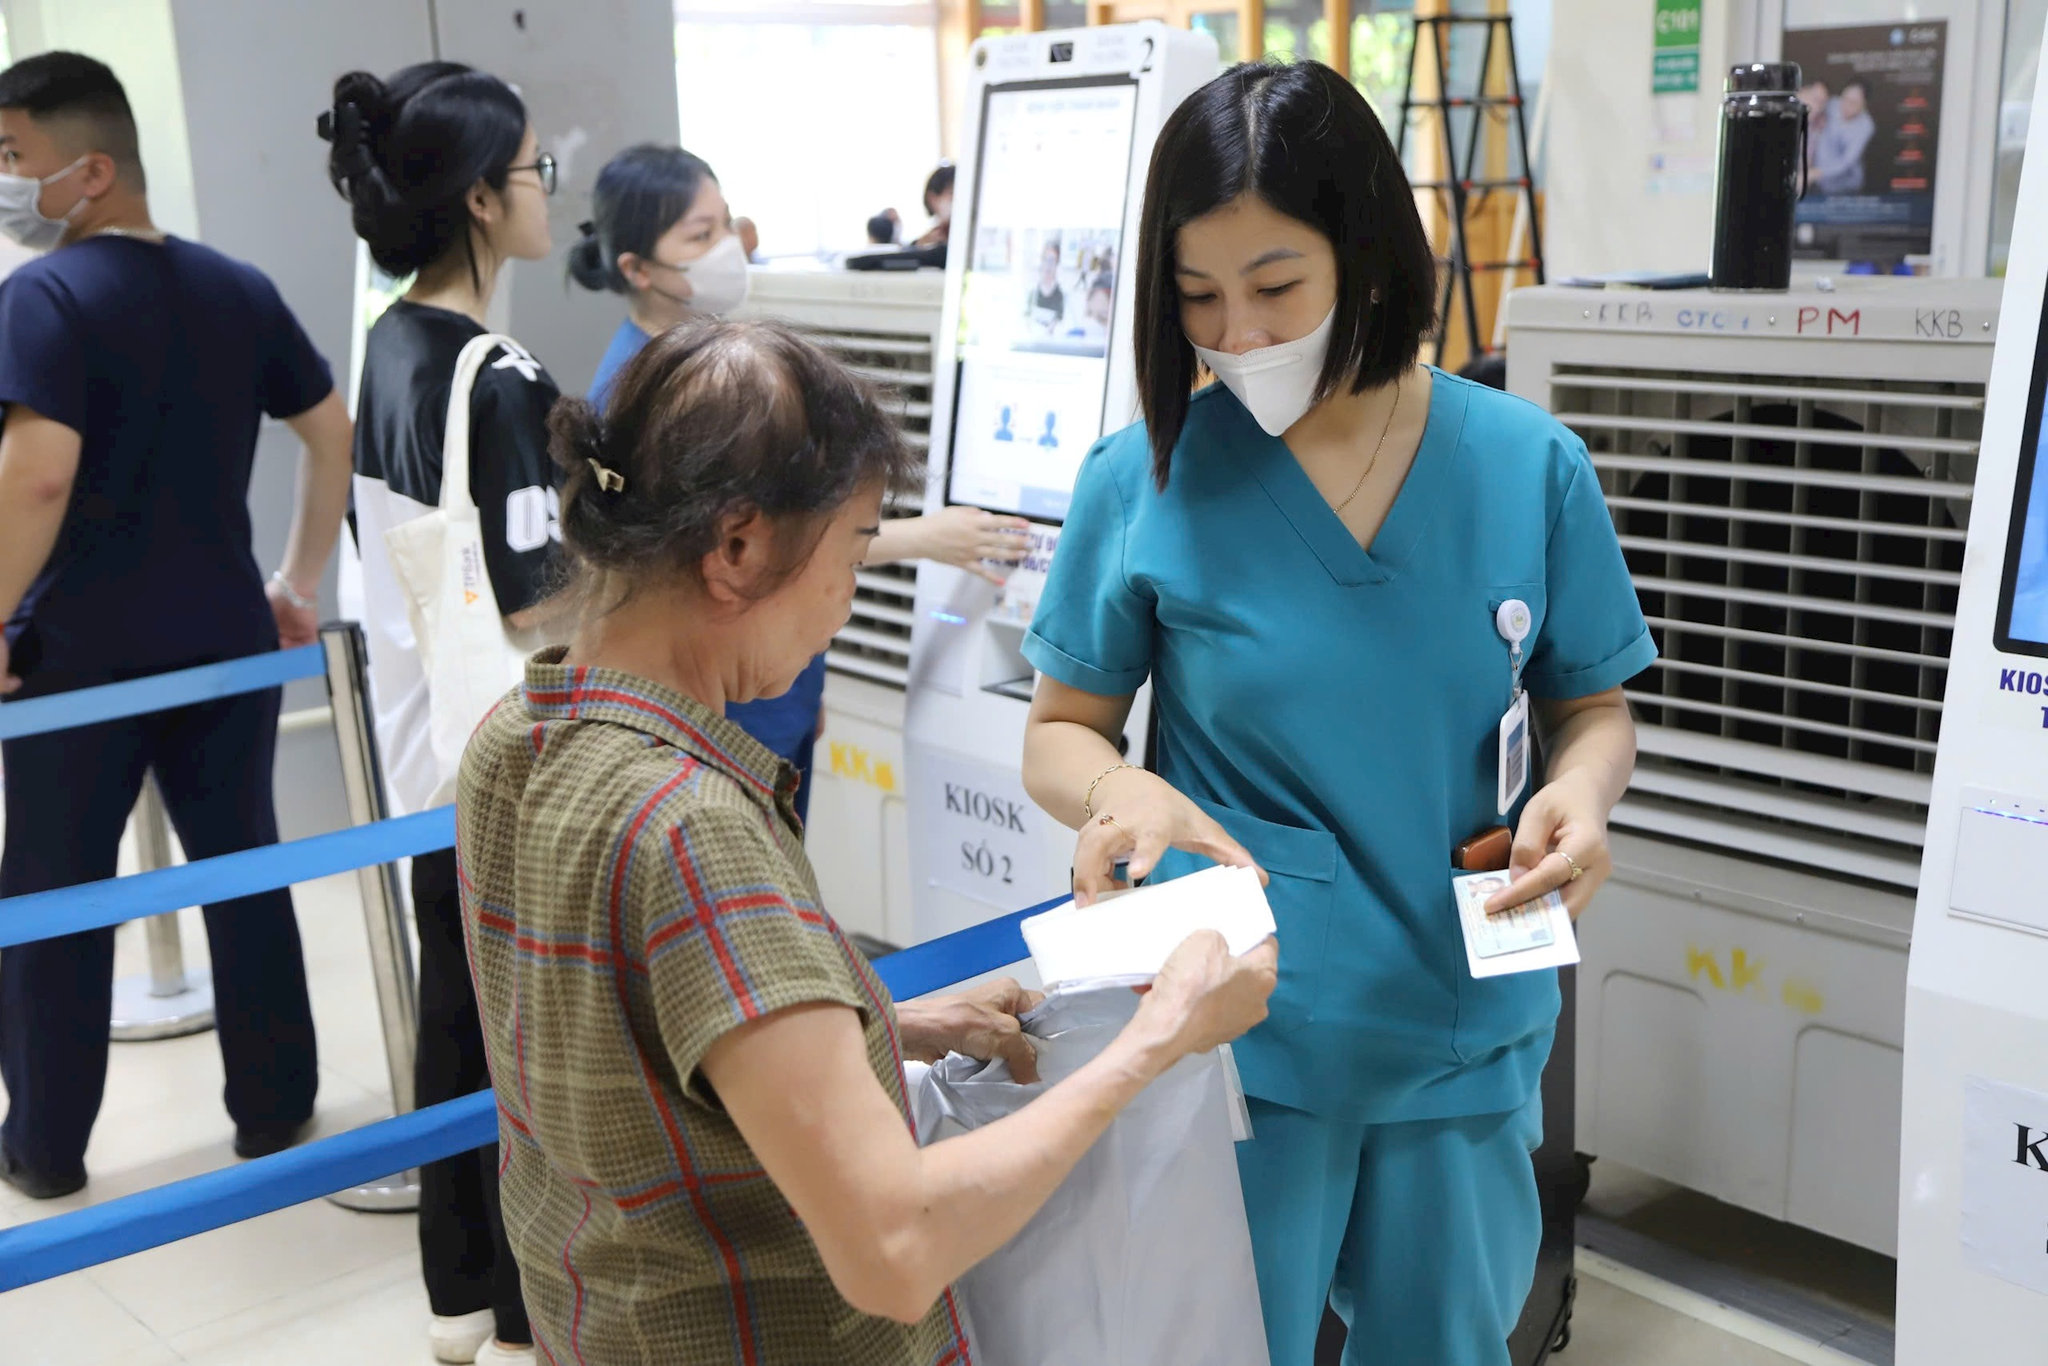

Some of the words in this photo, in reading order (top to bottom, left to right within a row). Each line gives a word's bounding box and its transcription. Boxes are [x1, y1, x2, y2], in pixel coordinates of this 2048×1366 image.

[1140, 37, 1154, 73] 2
[1797, 306, 1861, 336] PM
[1915, 307, 1964, 339] KKB
[945, 782, 1026, 834] KIOSK
[1001, 855, 1013, 884] 2
